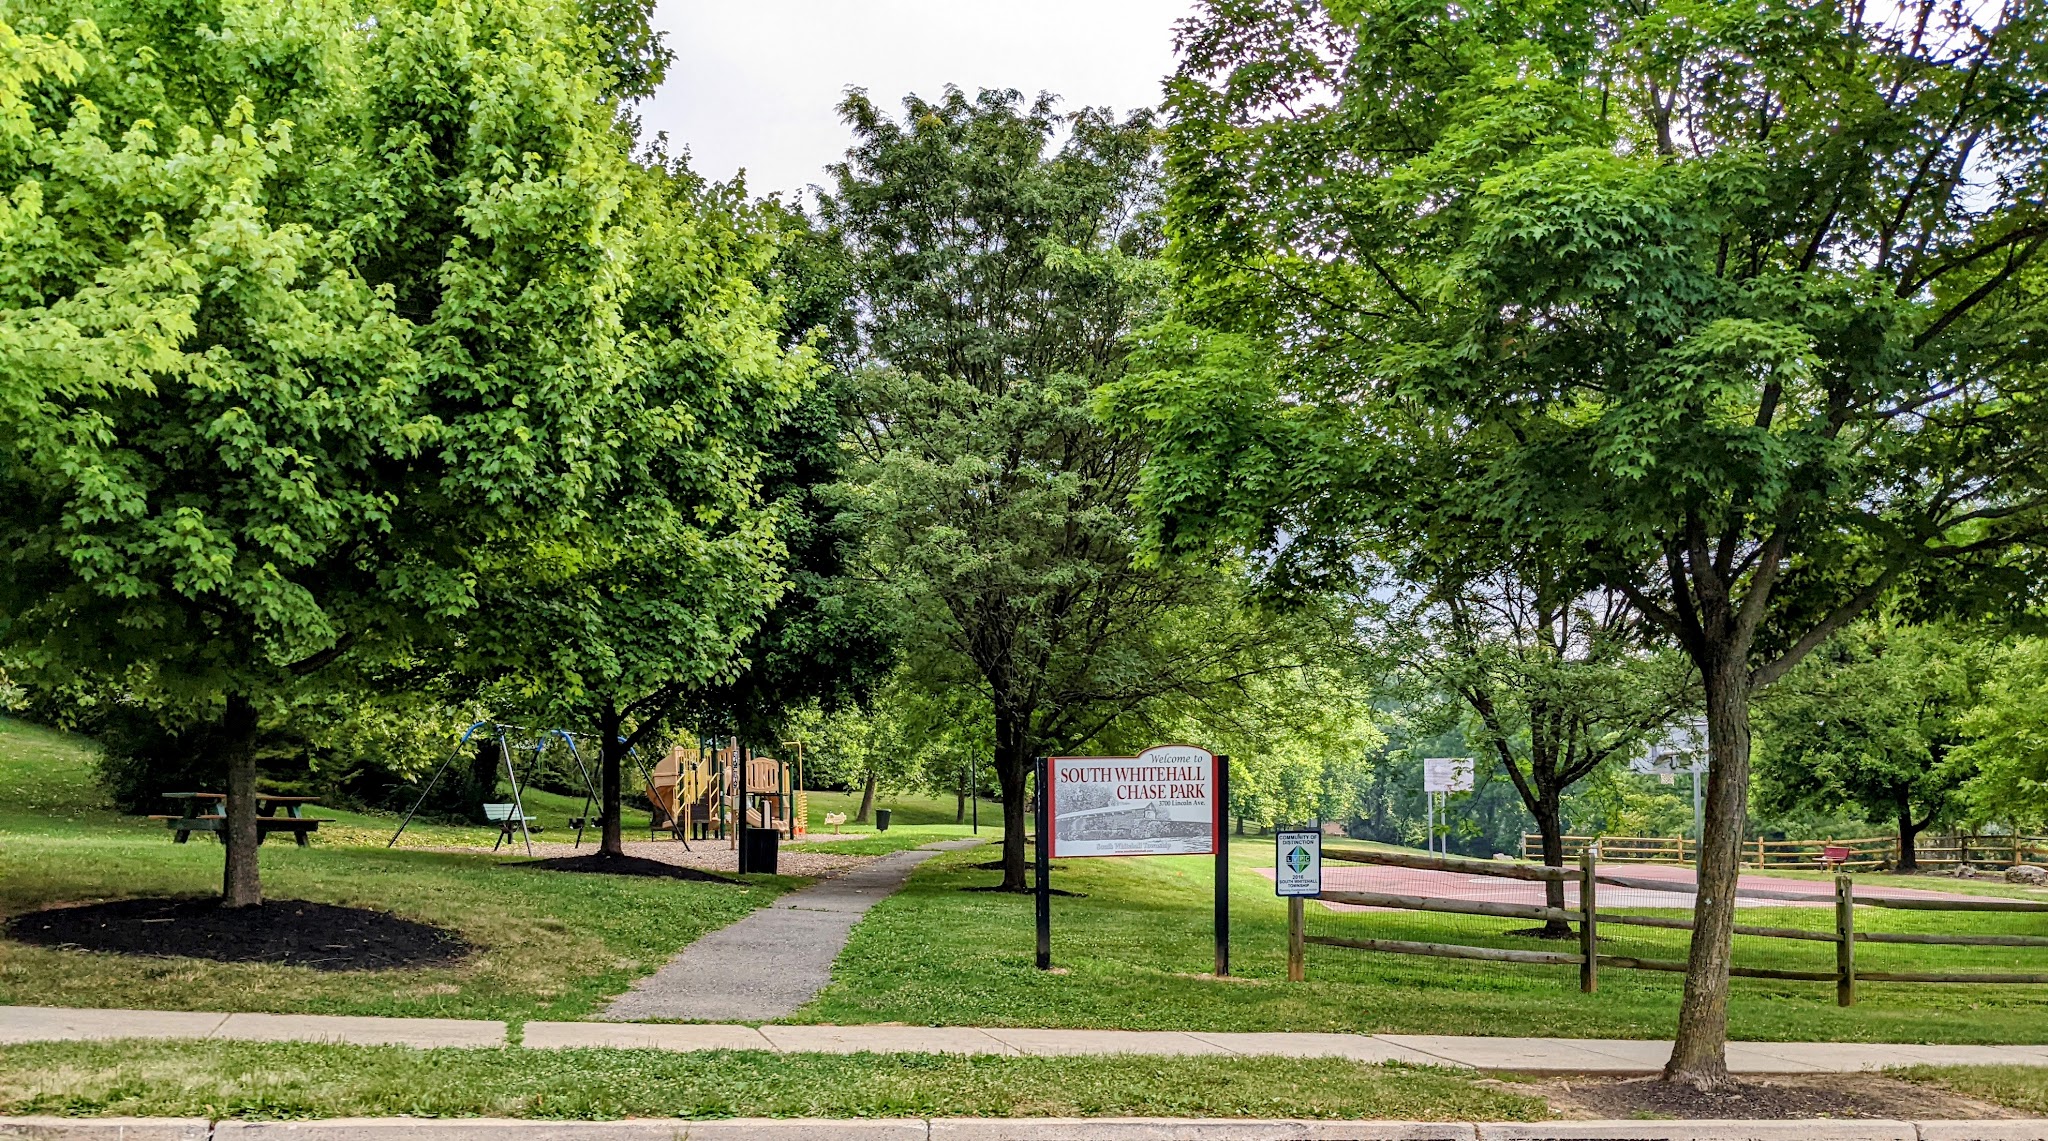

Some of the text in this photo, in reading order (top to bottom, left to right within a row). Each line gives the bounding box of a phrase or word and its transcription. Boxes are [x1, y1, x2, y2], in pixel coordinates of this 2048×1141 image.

[1149, 753, 1203, 763] Welcome to
[1060, 766, 1205, 783] SOUTH WHITEHALL
[1117, 783, 1205, 800] CHASE PARK
[1114, 842, 1143, 850] Whitehall
[1143, 842, 1172, 851] Township
